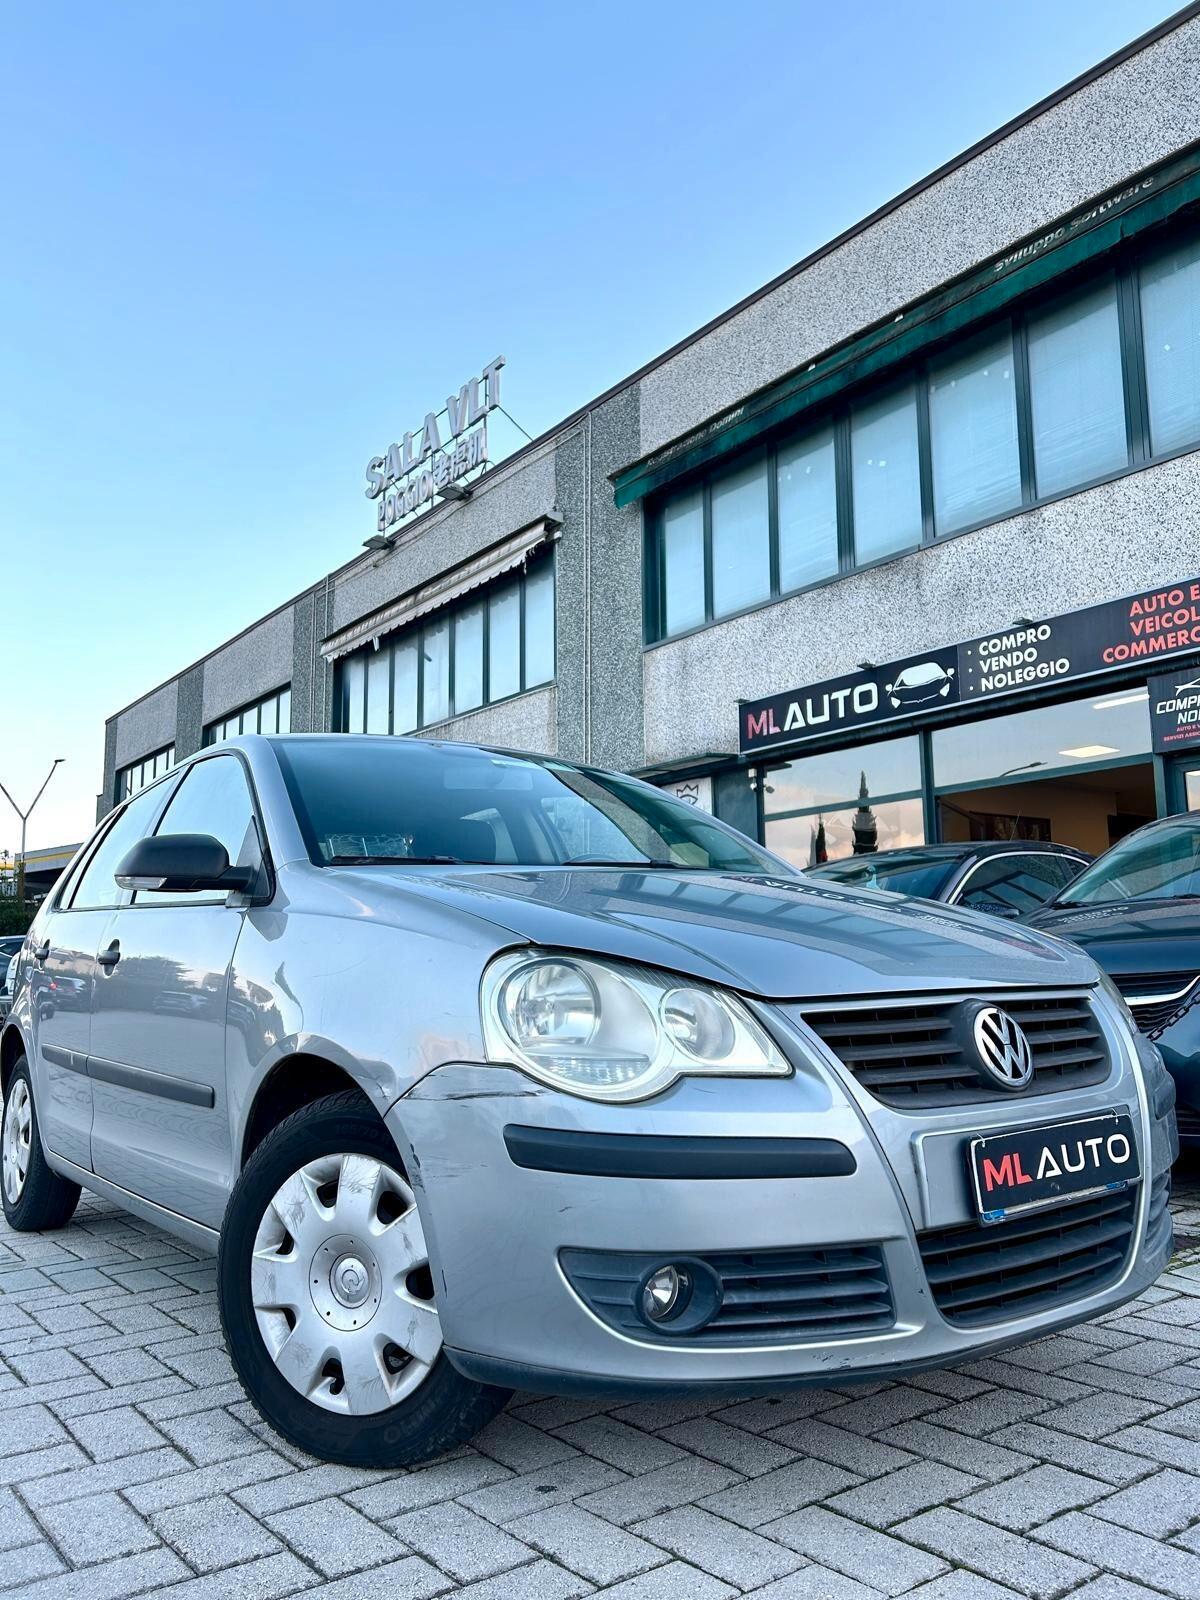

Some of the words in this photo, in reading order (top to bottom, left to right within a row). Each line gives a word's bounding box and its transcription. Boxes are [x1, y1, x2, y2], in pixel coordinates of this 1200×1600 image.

[365, 411, 441, 500] SALA
[446, 354, 506, 438] VLT
[377, 469, 433, 531] POGGIO
[1129, 589, 1184, 617] AUTO
[1190, 584, 1200, 601] E
[978, 624, 1051, 656] COMPRO
[979, 647, 1038, 674] VENDO
[980, 657, 1070, 693] NOLEGGIO
[1177, 710, 1200, 724] NO
